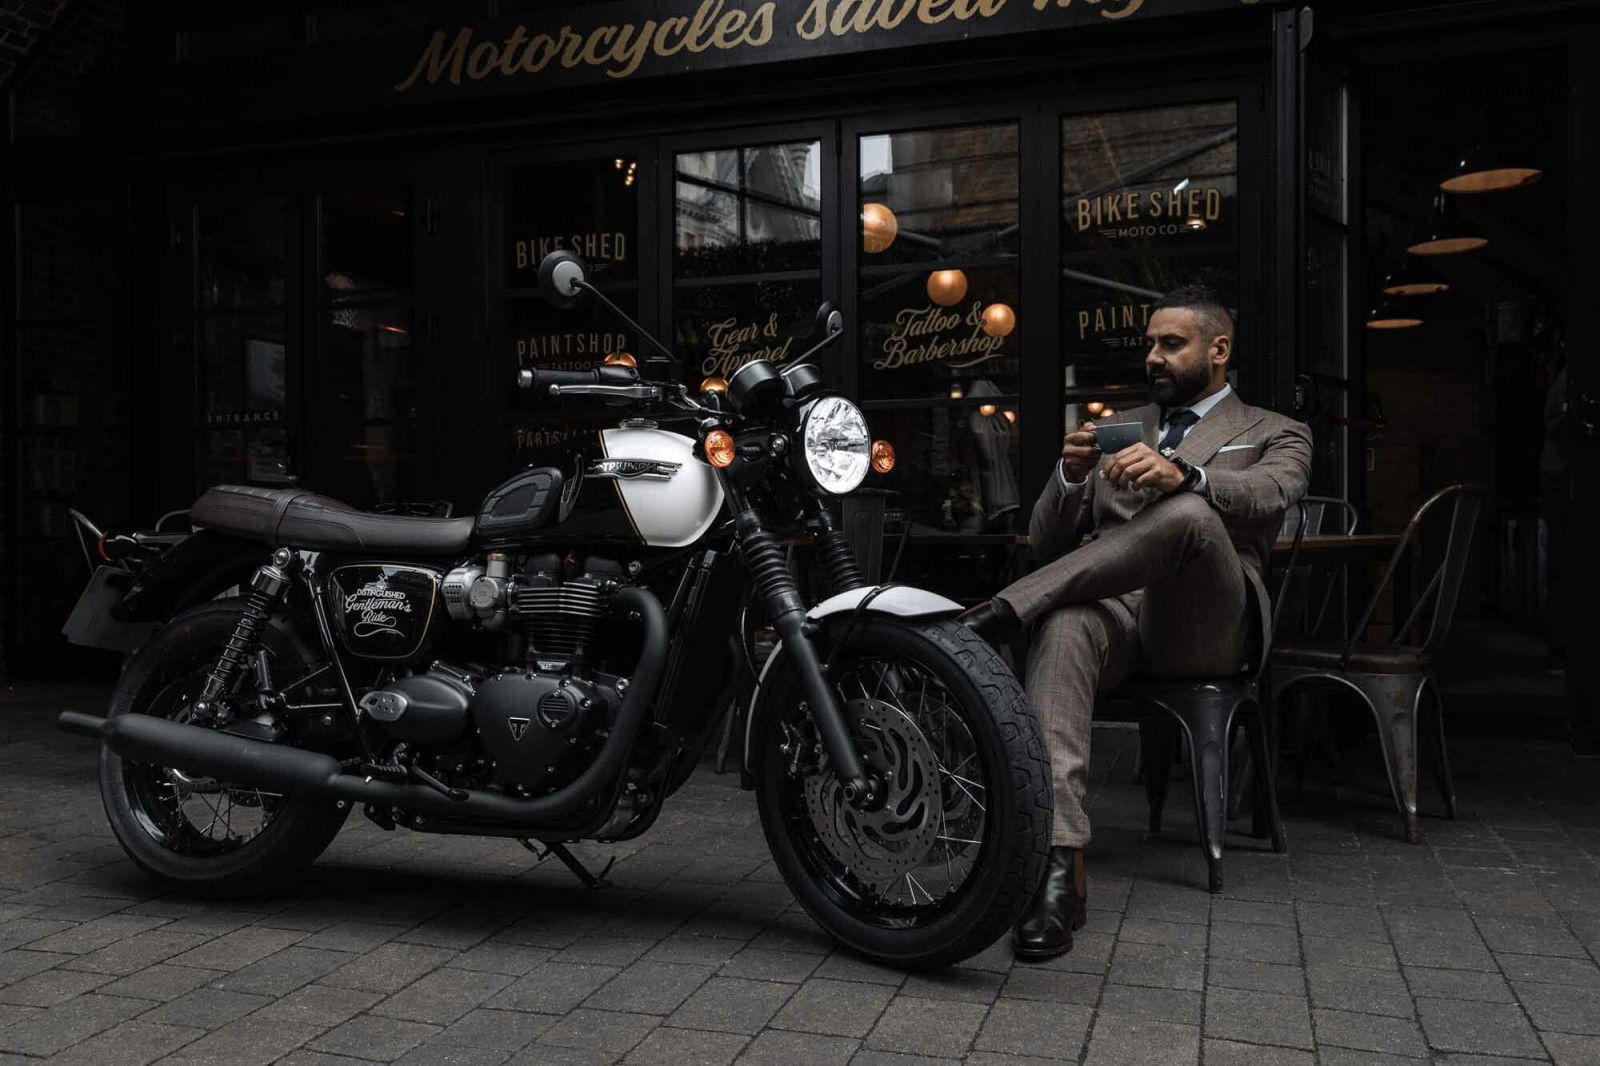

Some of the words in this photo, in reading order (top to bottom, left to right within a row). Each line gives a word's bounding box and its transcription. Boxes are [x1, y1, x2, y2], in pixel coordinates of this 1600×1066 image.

[393, 0, 777, 95] Motorcycles
[1077, 193, 1140, 232] BIKE
[1150, 188, 1221, 221] SHED
[516, 236, 565, 270] BIKE
[571, 231, 626, 261] SHED
[1119, 225, 1156, 238] MOTO
[1158, 224, 1178, 236] CO
[707, 317, 761, 351] Gear
[762, 311, 779, 337] &
[891, 302, 961, 340] Tattoo
[965, 300, 984, 326] &
[516, 332, 627, 366] PAINTSHOP
[701, 335, 794, 379] Apparel
[873, 321, 1006, 370] Barbershop
[345, 594, 412, 613] Gentleman's
[357, 589, 406, 599] DISTINGUISHED
